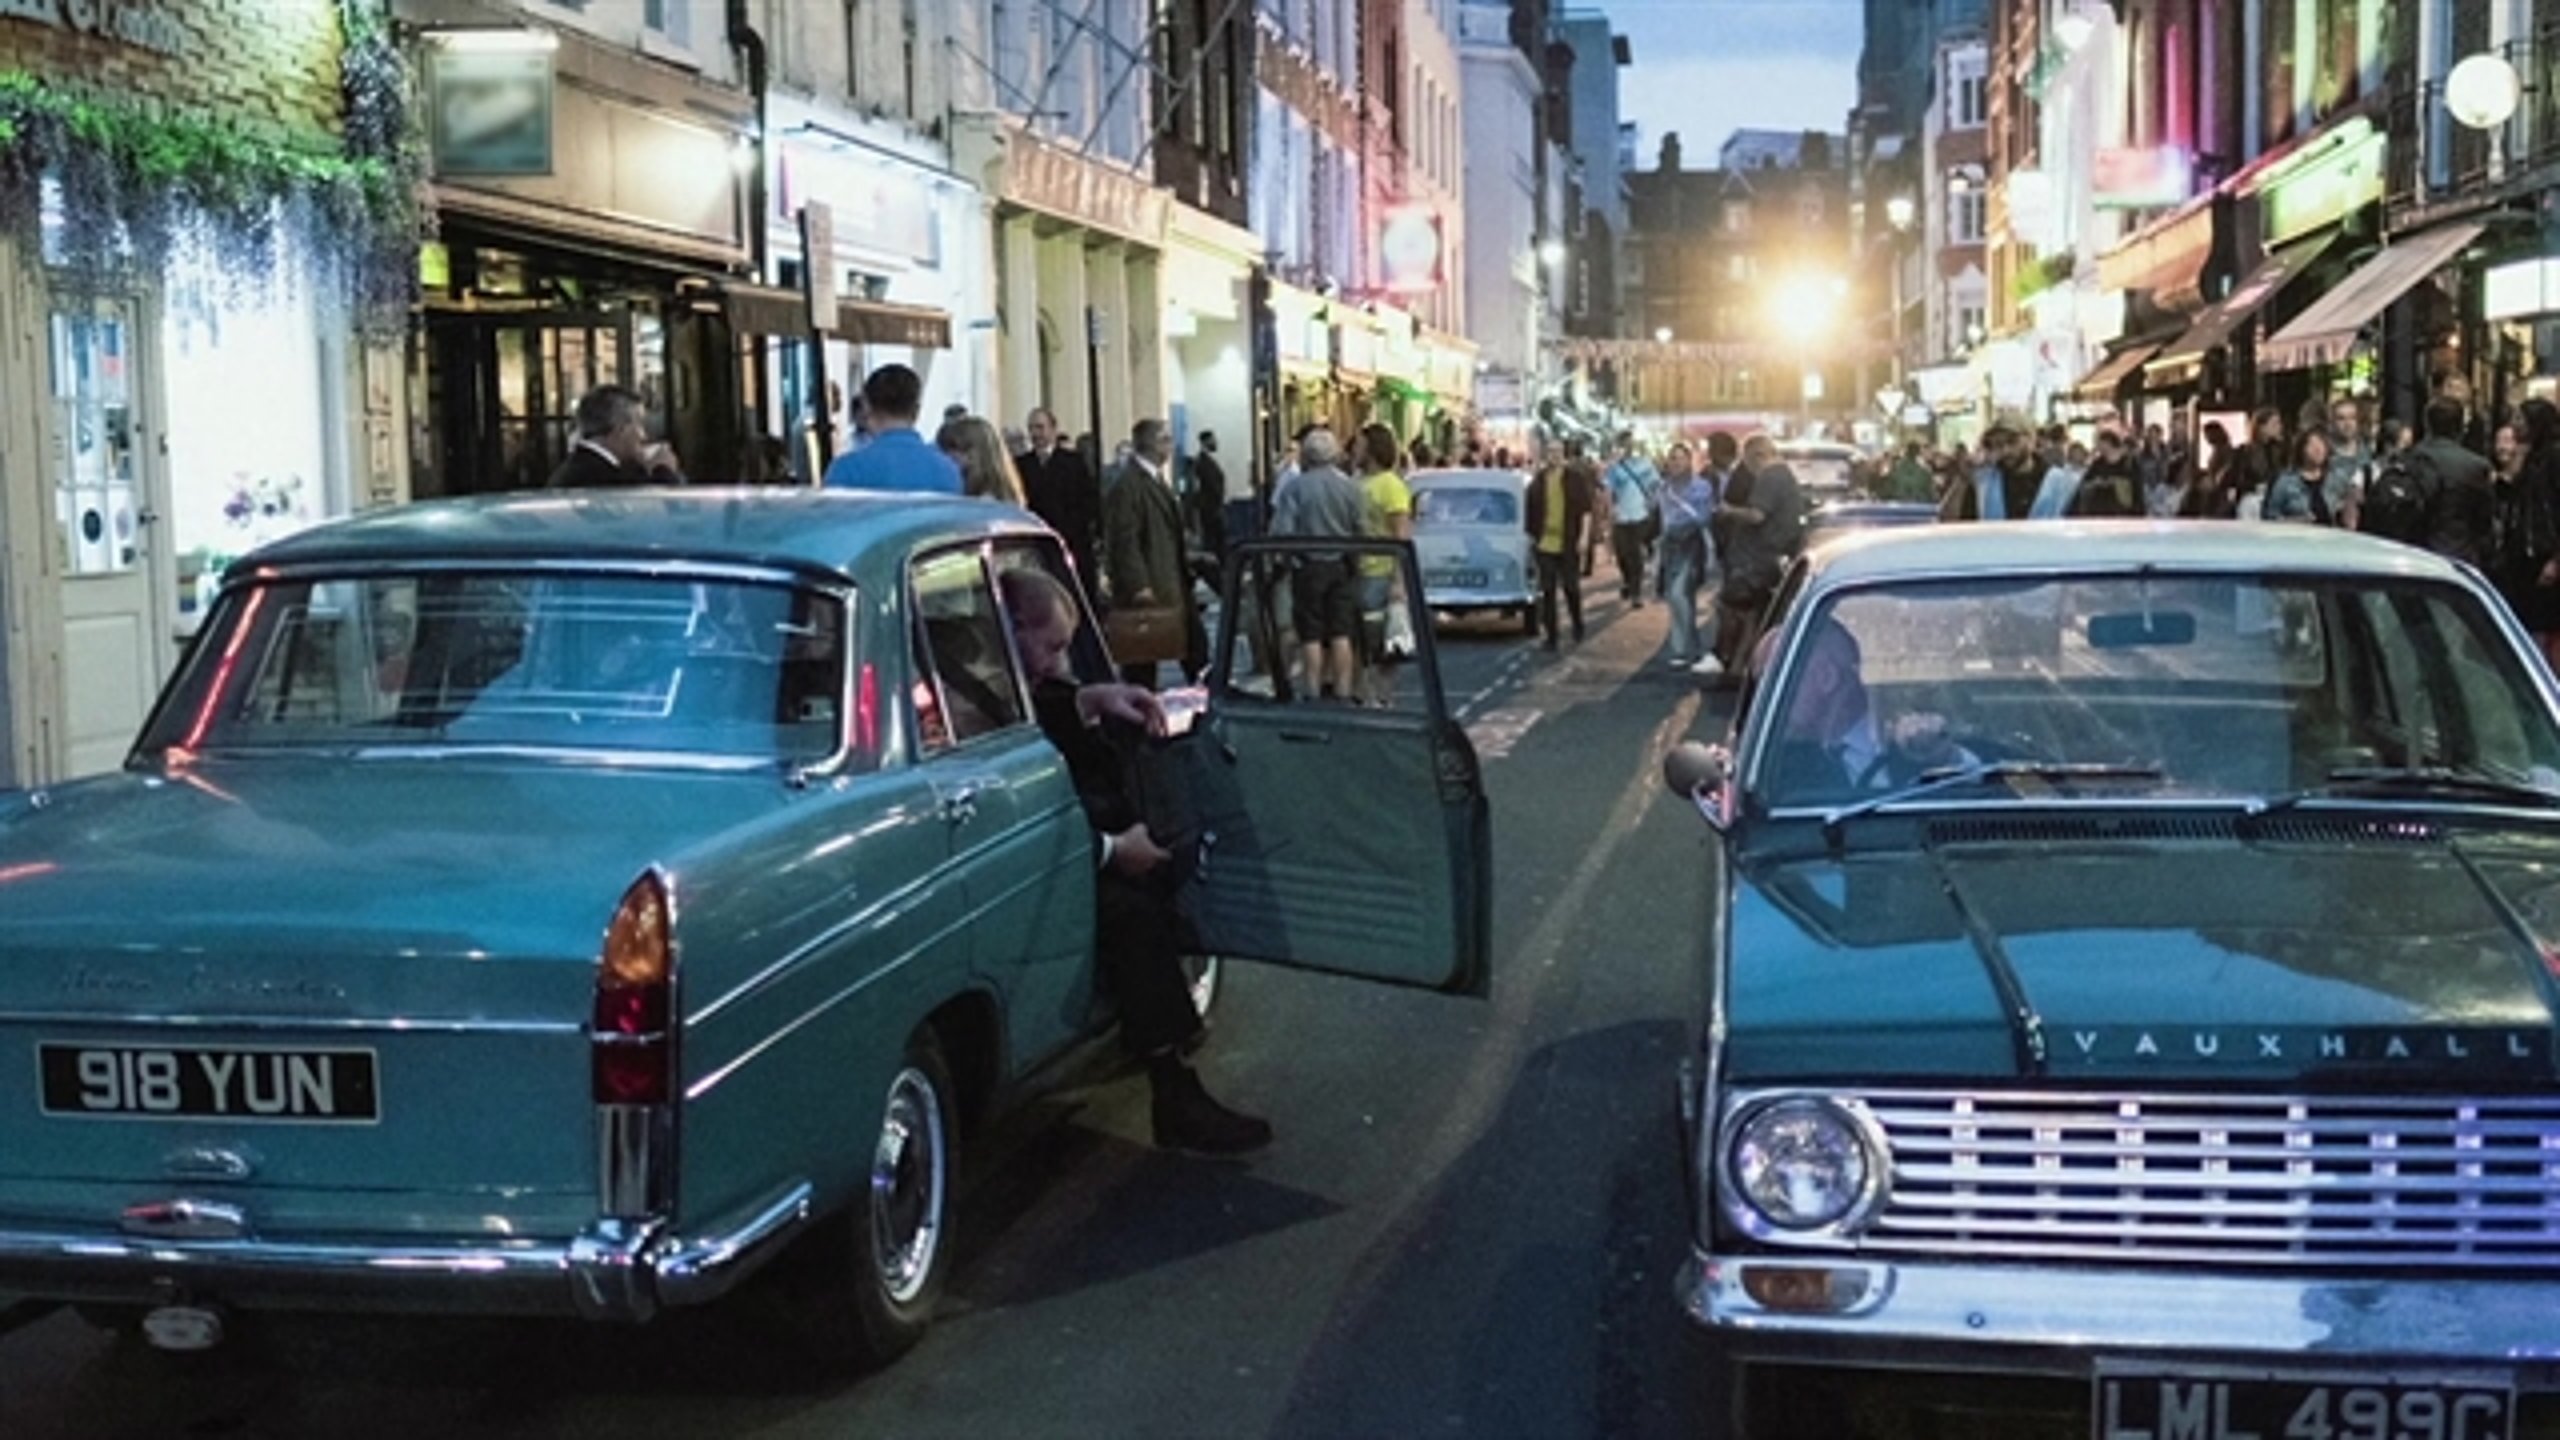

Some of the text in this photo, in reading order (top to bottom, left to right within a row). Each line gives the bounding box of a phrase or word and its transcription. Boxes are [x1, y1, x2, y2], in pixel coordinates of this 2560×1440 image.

[2074, 1031, 2530, 1057] VAUXHALL
[77, 1050, 335, 1113] 918 YUN
[2105, 1381, 2500, 1440] LML 499C
